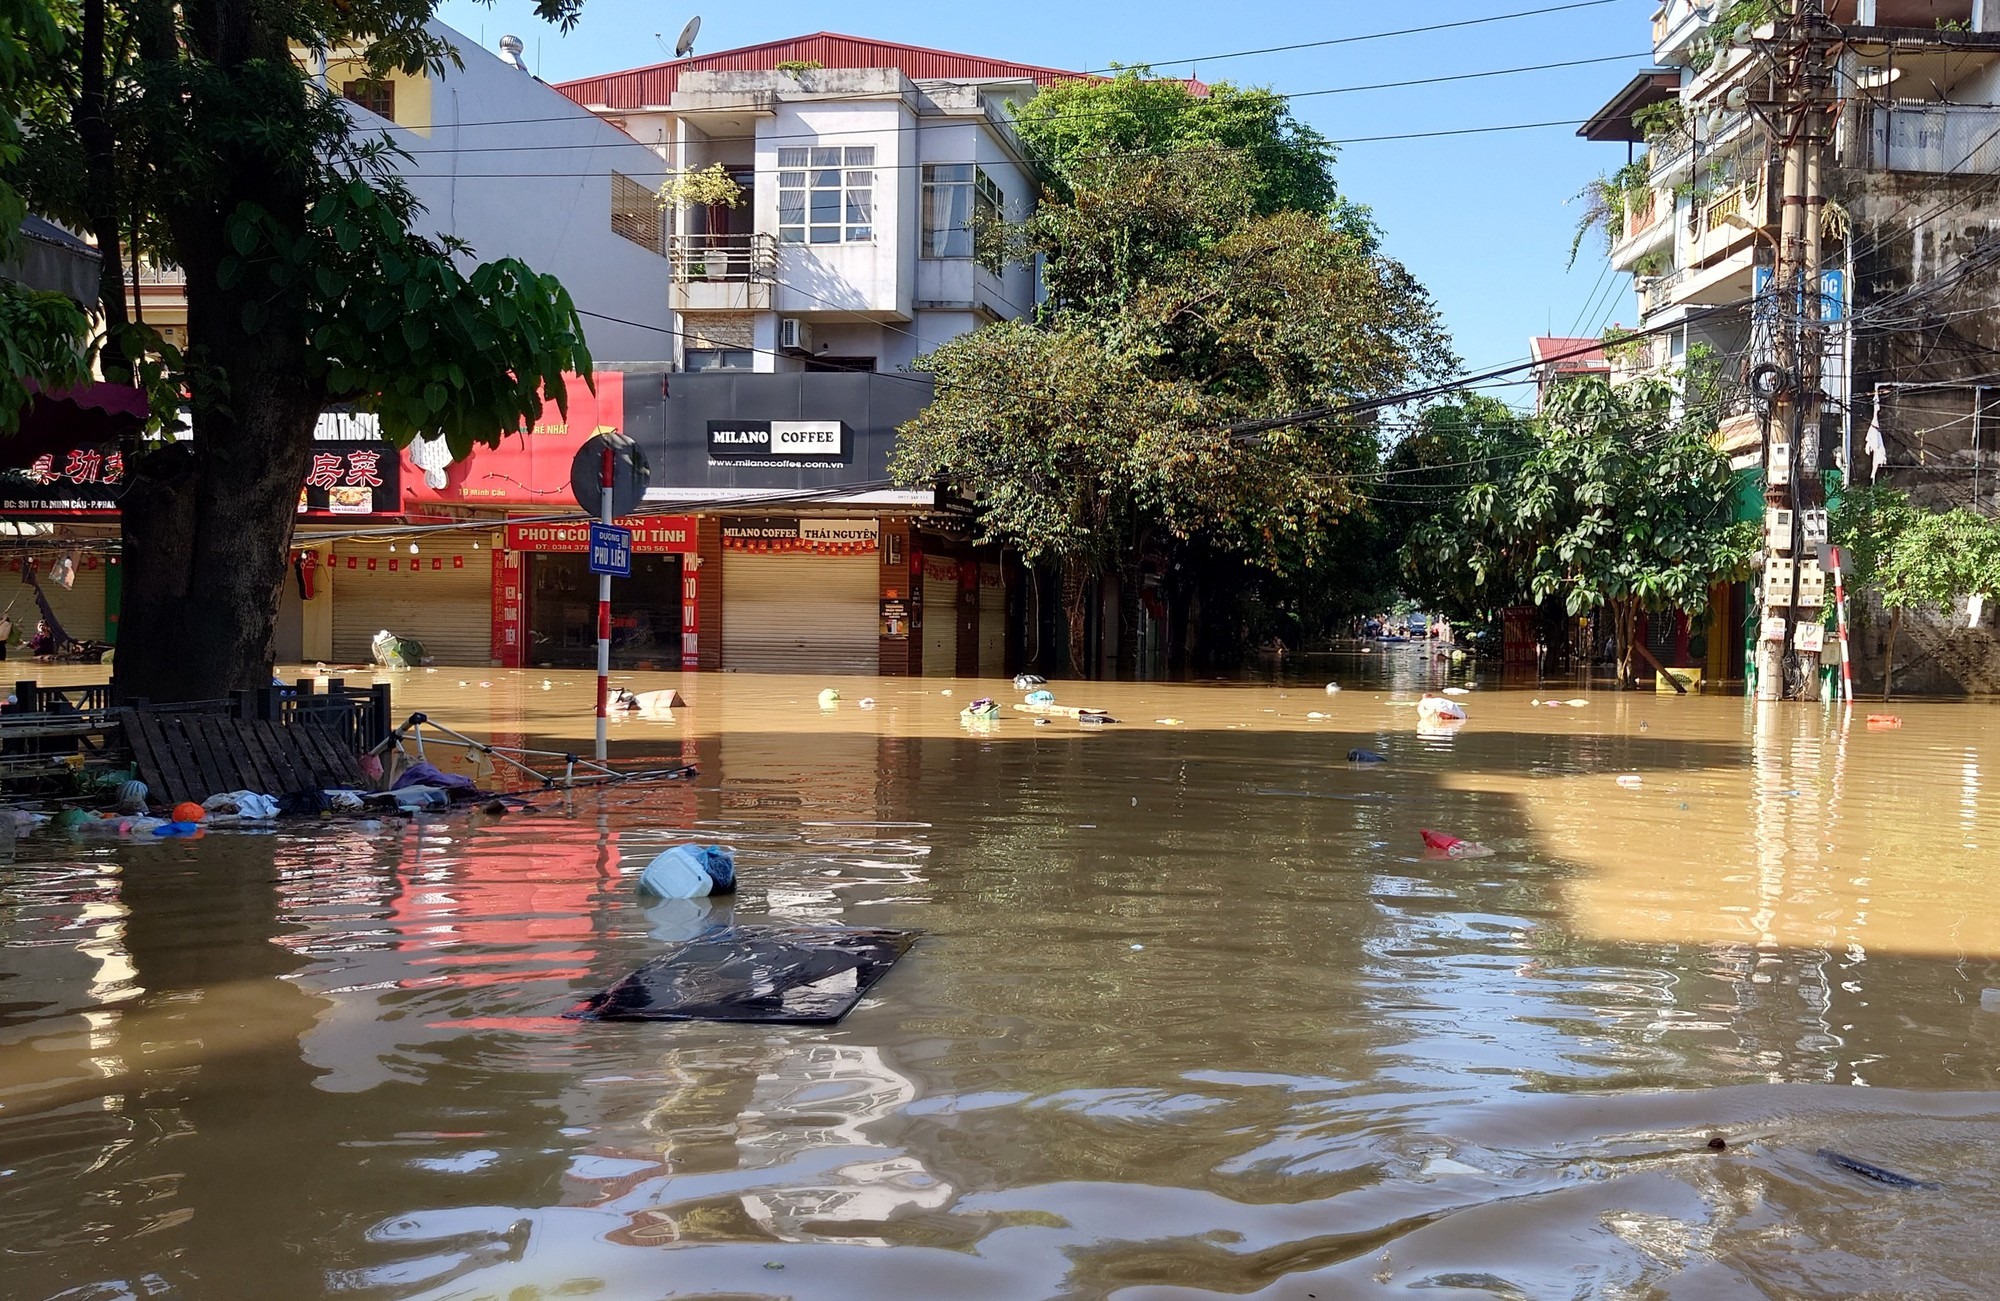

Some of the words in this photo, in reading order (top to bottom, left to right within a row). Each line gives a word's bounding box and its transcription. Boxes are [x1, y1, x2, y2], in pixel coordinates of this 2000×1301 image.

[713, 431, 769, 444] MILANO
[781, 431, 834, 443] COFFEE
[707, 459, 844, 469] www.milanocoffee.com.vn
[307, 450, 383, 491] 房菜
[470, 488, 490, 496] Minh
[18, 500, 29, 509] SN
[31, 500, 39, 509] 17
[50, 500, 69, 509] MINH
[632, 529, 647, 542] VI
[651, 528, 686, 542] TÍNH
[723, 528, 761, 537] MILANO
[762, 528, 798, 538] COFFEE
[804, 528, 830, 539] THÁI
[832, 528, 878, 539] NGUYÊN
[594, 541, 609, 565] PHÙ
[636, 544, 652, 552] 839
[684, 605, 695, 627] VI
[683, 628, 698, 654] TÍNH
